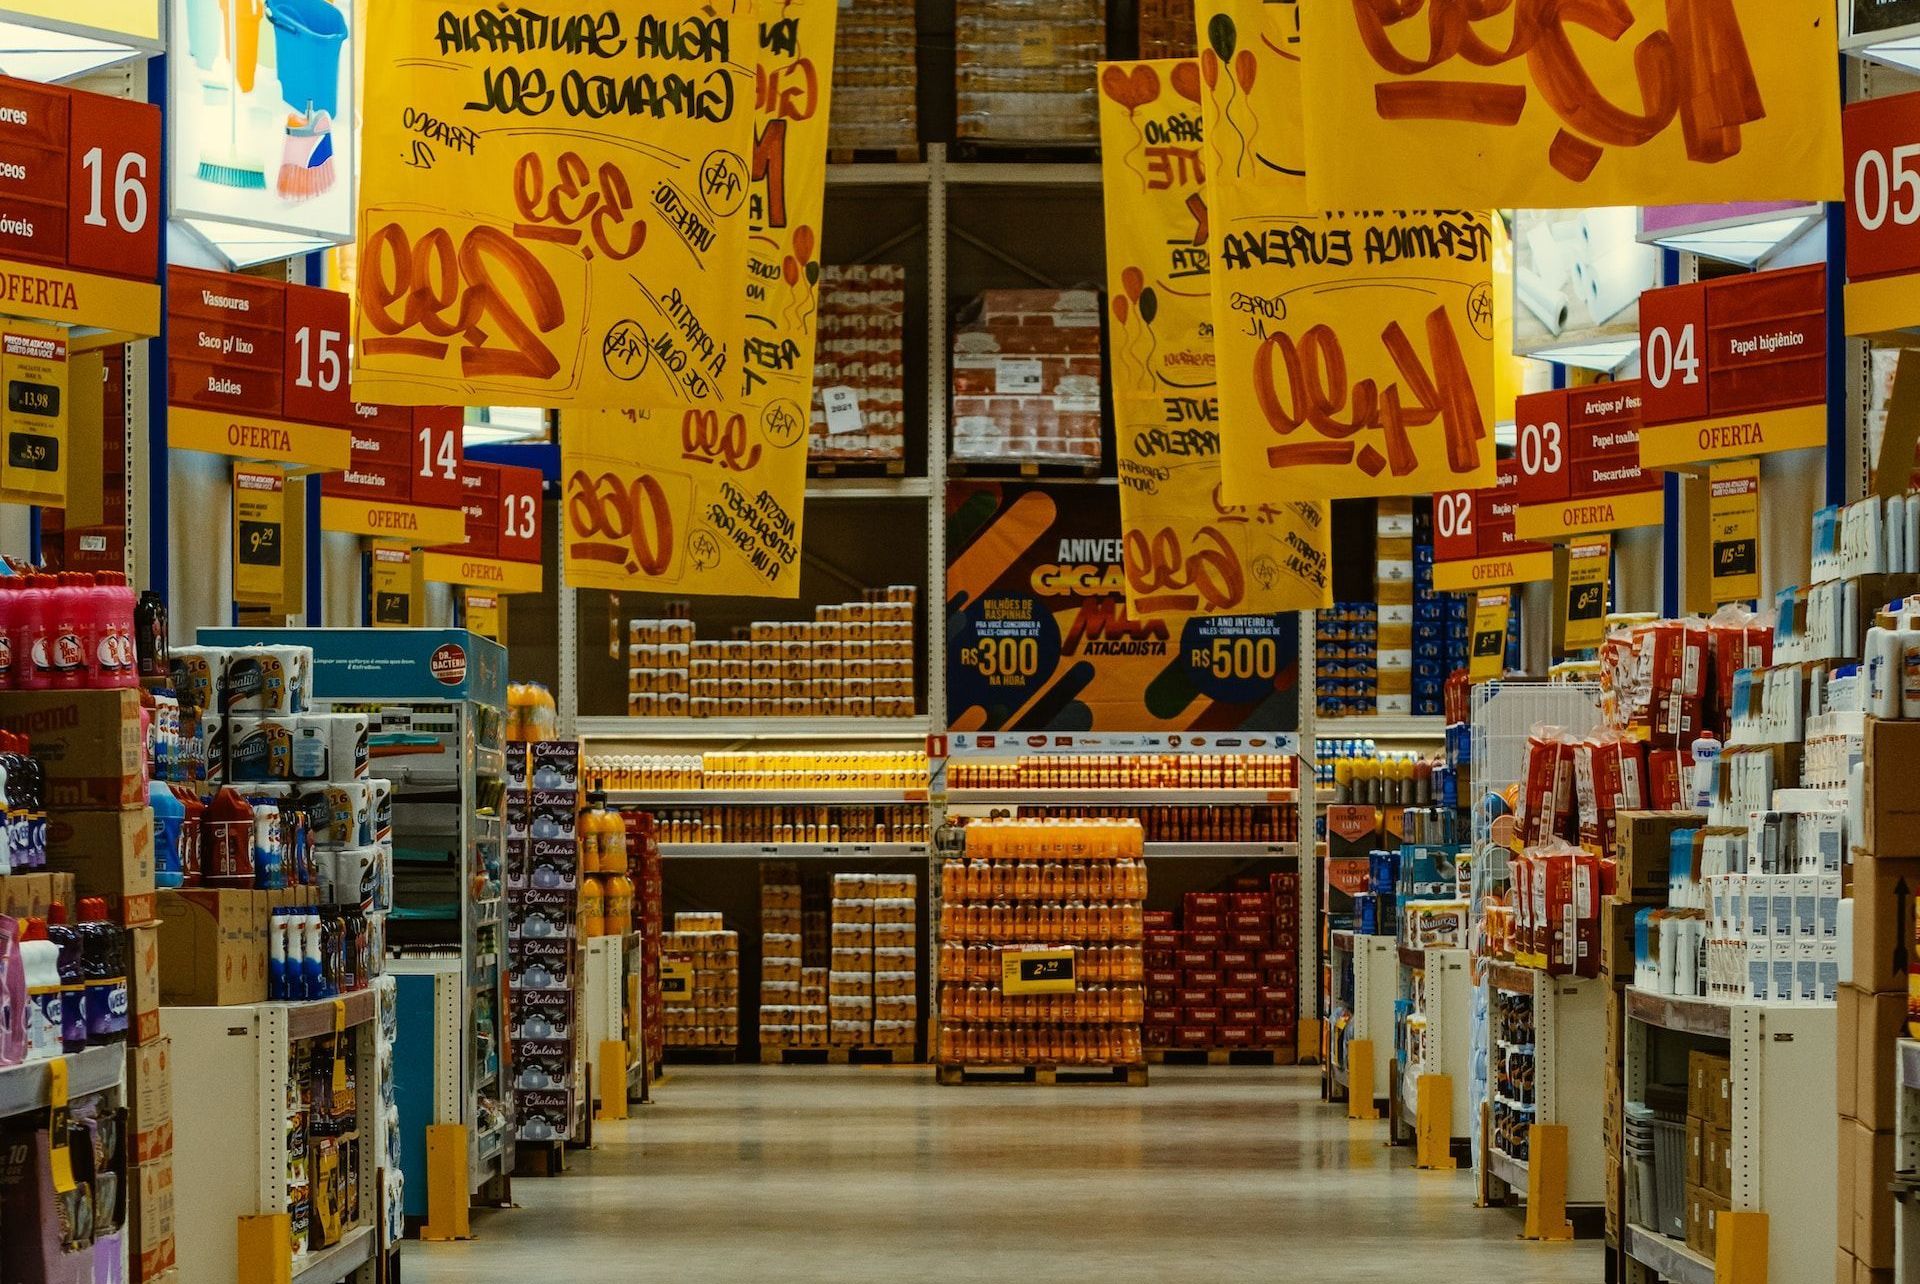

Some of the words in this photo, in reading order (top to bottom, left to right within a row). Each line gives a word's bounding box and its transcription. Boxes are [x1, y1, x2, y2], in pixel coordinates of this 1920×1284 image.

[83, 147, 148, 233] 16
[1854, 142, 1920, 231] 05
[202, 290, 250, 311] Vassouras
[198, 331, 221, 349] Saco
[222, 335, 234, 354] p/
[235, 338, 254, 354] lixo
[1730, 337, 1758, 356] Papel
[1759, 331, 1804, 353] higiênico
[295, 326, 341, 392] 15
[1647, 323, 1699, 389] 04
[207, 377, 242, 395] Baldes
[24, 391, 49, 408] 13,98
[833, 391, 846, 401] 03
[355, 402, 378, 418] Copos
[1585, 400, 1614, 416] Artigos
[1615, 396, 1624, 413] p/
[228, 424, 291, 452] OFERTA
[351, 436, 380, 451] Panelas
[1592, 433, 1614, 449] Papel
[1698, 422, 1764, 450] OFERTA
[419, 427, 457, 480] 14
[1521, 421, 1562, 476] 03
[344, 469, 386, 487] Refratários
[1593, 465, 1642, 482] Descartáveis
[504, 494, 536, 539] 13
[1437, 492, 1472, 538] 02
[1492, 504, 1512, 516] Ração
[1563, 504, 1615, 526] OFERTA
[368, 509, 418, 531] OFERTA
[1502, 531, 1513, 543] Pet
[462, 562, 503, 581] OFERTA
[1472, 561, 1514, 580] OFERTA
[983, 598, 1020, 610] MILHÕES
[1021, 599, 1033, 610] DE
[984, 610, 1032, 620] RASPINHAS
[1217, 617, 1234, 626] ANO
[1235, 617, 1265, 627] INTEIRO
[438, 651, 452, 660] DR.
[961, 647, 978, 666] R$
[978, 637, 1038, 676] 300
[1084, 641, 1167, 656] ATACADISTA
[262, 660, 280, 673] 16
[1191, 648, 1210, 669] R$
[1212, 637, 1276, 679] 500
[188, 660, 206, 674] 16
[1003, 675, 1026, 686] HORA
[268, 728, 286, 742] 16
[535, 743, 576, 756] Chaleira
[330, 793, 348, 804] 16
[534, 792, 575, 806] Chaleira
[534, 841, 575, 856] Chaleira
[524, 889, 566, 904] Chaleira
[524, 942, 566, 956] Chaleira
[524, 991, 566, 1005] Chaleira
[522, 1042, 563, 1056] Chaleira
